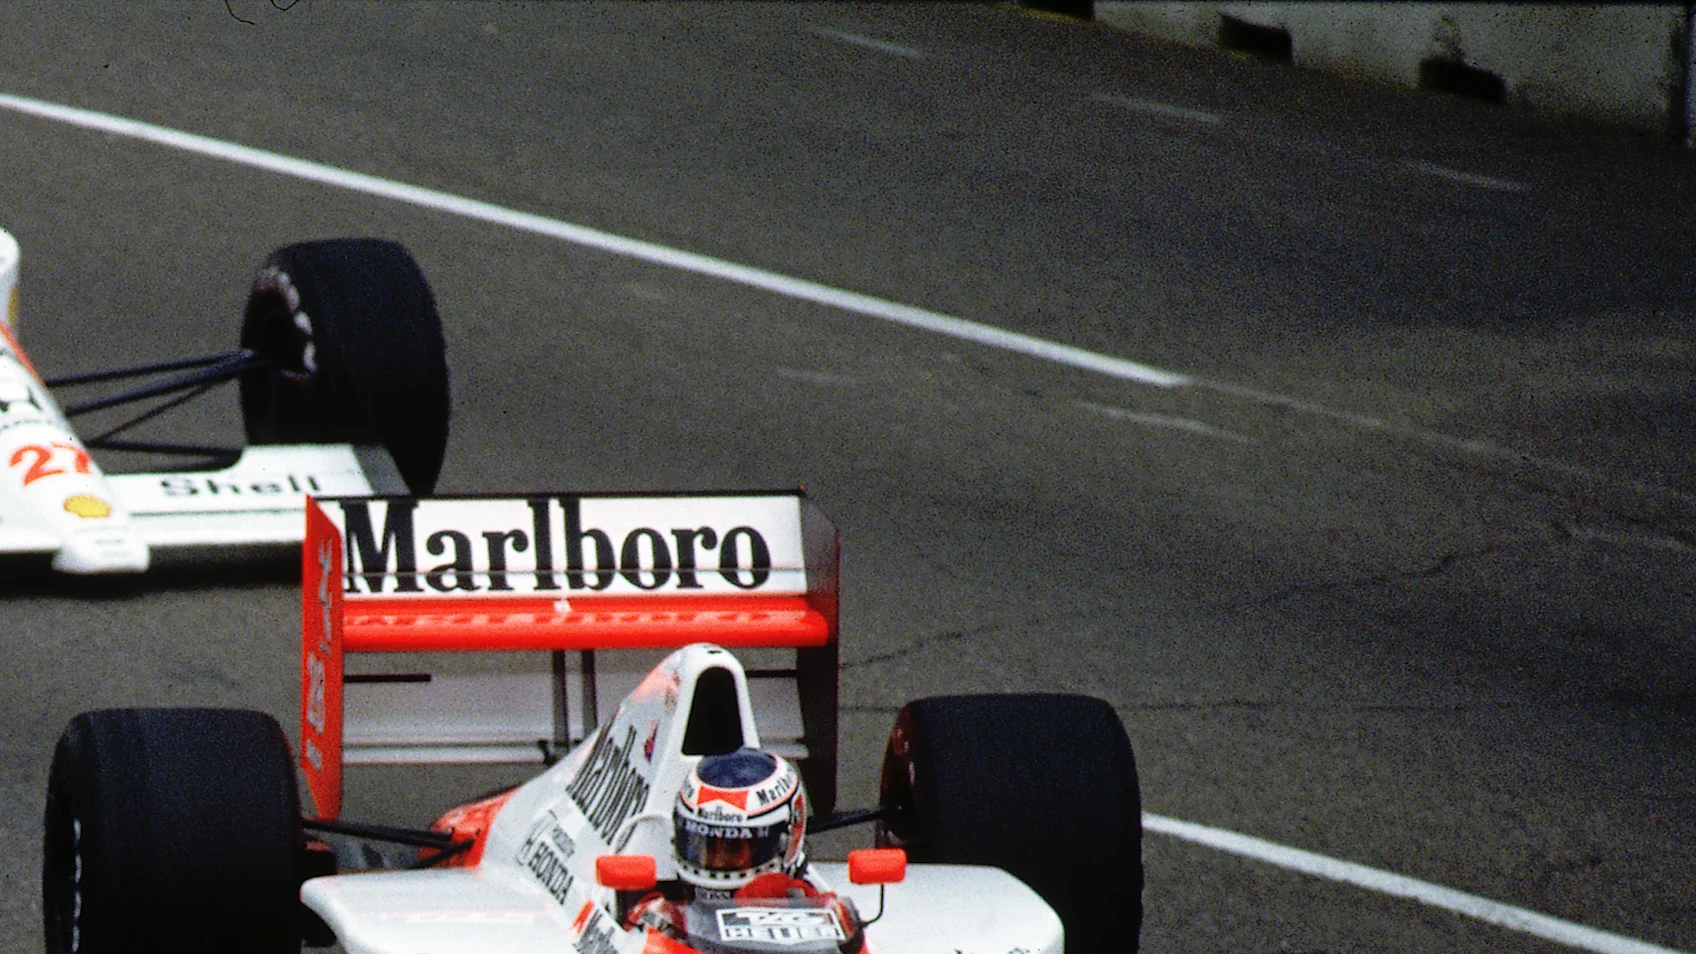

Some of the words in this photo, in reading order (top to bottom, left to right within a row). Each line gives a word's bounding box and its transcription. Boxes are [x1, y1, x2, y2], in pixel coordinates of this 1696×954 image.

[9, 442, 91, 486] 27
[160, 475, 319, 496] Shell
[339, 498, 772, 594] Marlboro
[528, 841, 574, 905] HONDA
